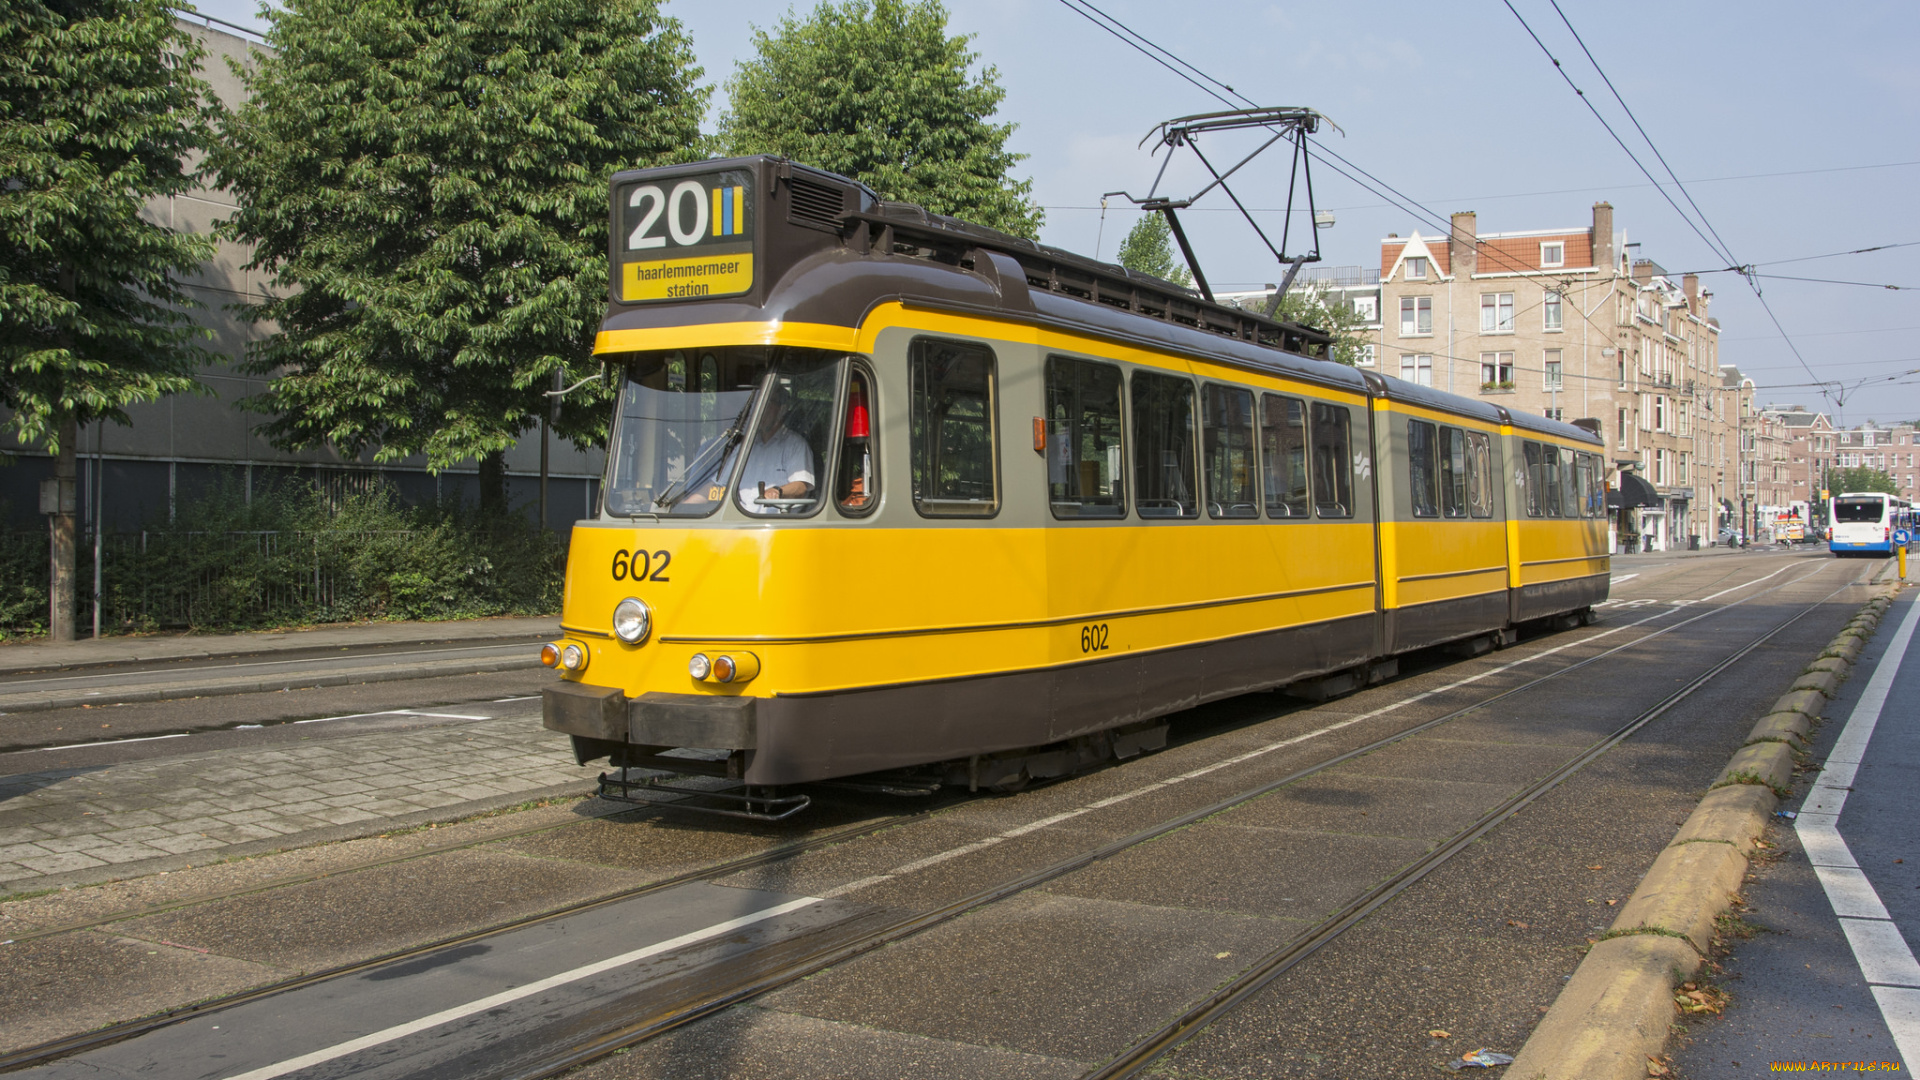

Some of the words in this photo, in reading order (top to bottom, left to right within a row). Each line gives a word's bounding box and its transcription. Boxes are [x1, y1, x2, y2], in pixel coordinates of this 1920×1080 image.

[629, 180, 709, 250] 20
[637, 261, 740, 281] haarlemmermeer
[667, 281, 709, 298] station
[611, 549, 671, 582] 602
[1081, 623, 1109, 653] 602
